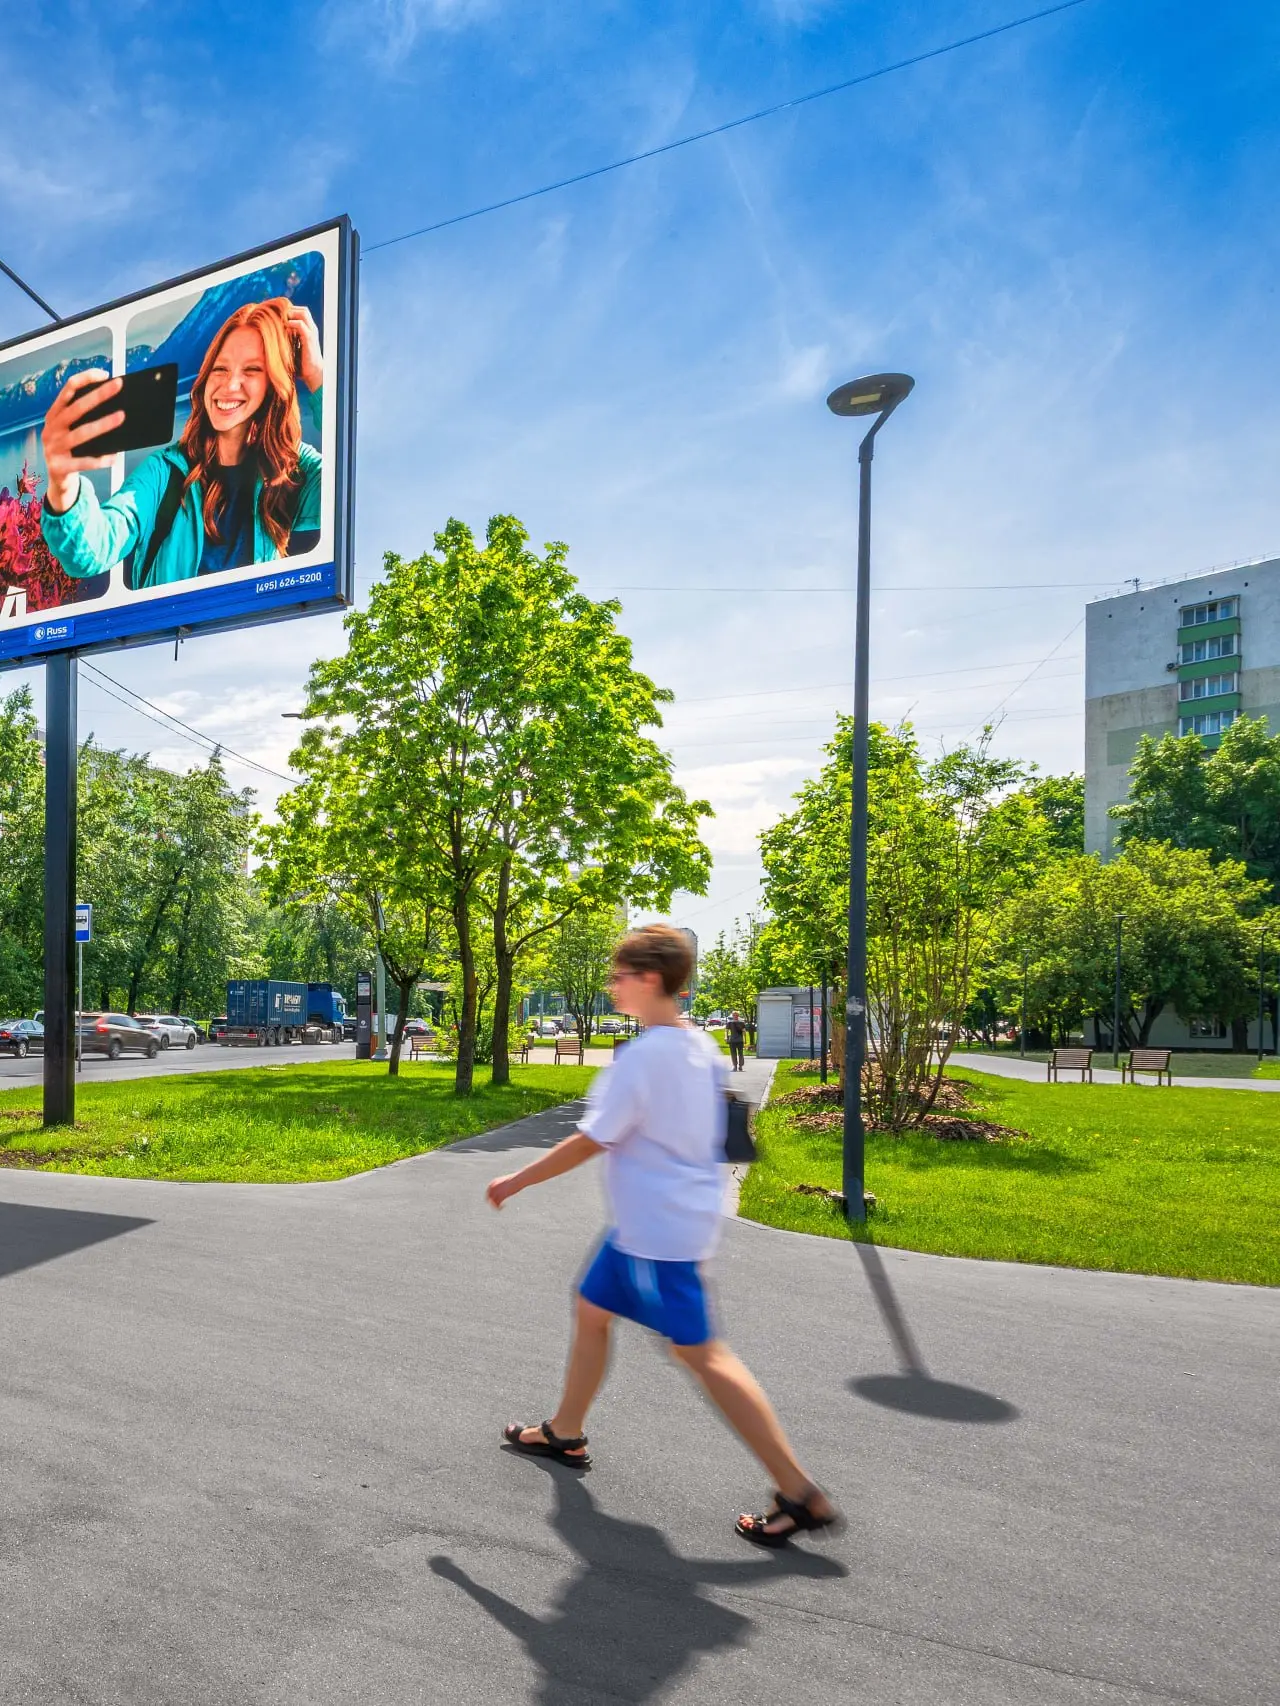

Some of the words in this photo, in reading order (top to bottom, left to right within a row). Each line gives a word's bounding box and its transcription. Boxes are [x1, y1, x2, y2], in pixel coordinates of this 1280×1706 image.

[256, 580, 277, 593] (495)
[279, 572, 322, 587] 626-5200
[46, 626, 68, 636] Russ
